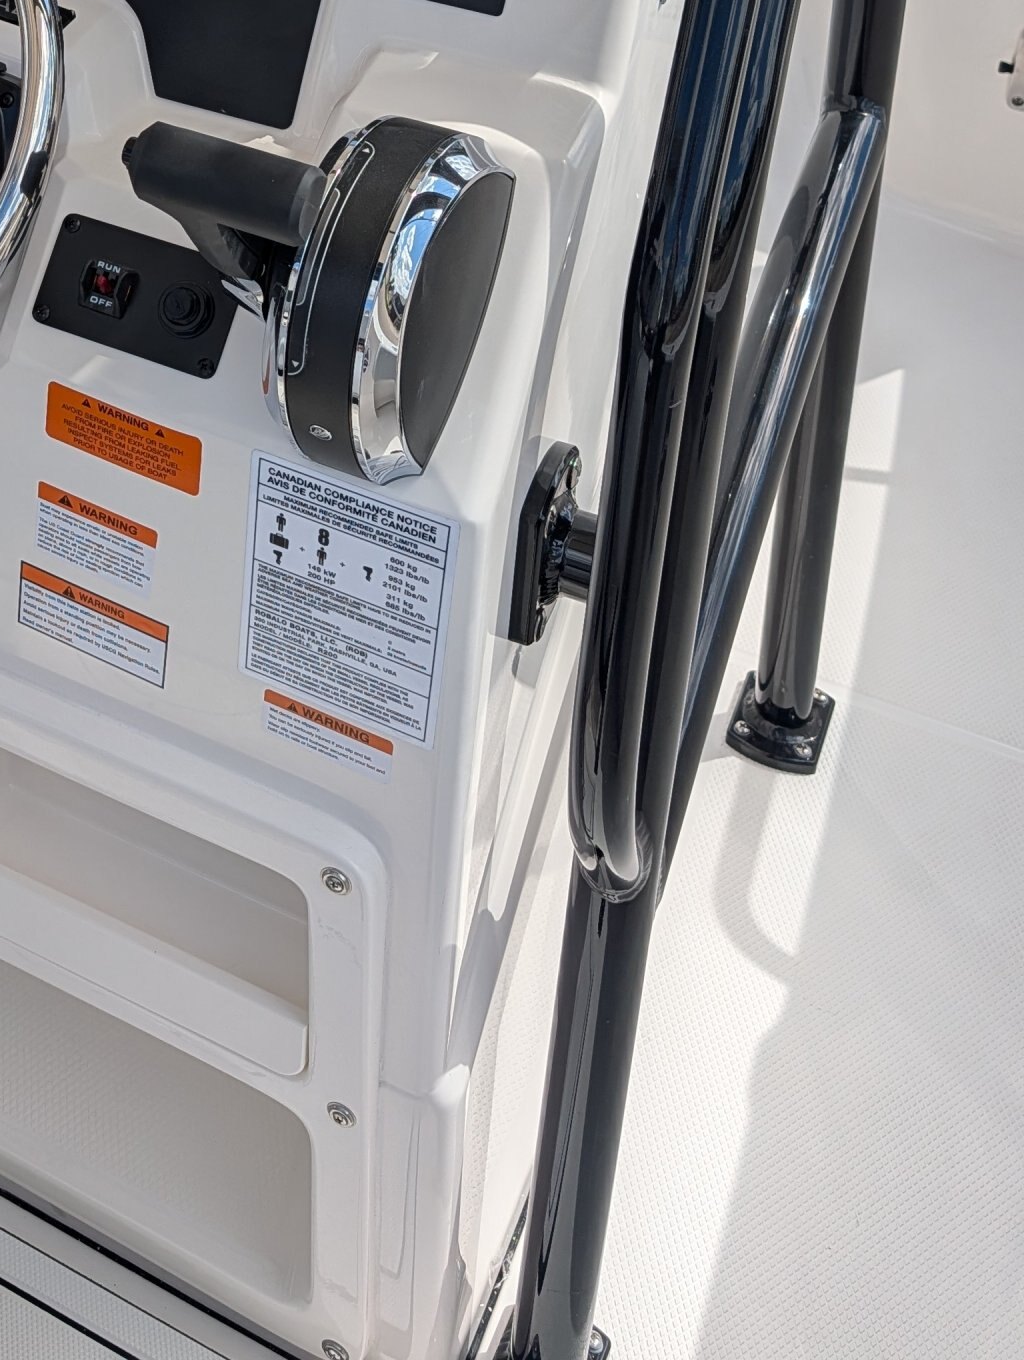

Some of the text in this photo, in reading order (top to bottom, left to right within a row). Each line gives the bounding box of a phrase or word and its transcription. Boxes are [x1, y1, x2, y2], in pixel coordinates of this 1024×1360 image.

[97, 260, 121, 274] RUN
[89, 295, 113, 308] OFF
[61, 402, 183, 457] AVOID SERIOUS INJURY OR DEATH
[97, 402, 149, 432] WARNING
[63, 418, 102, 440] RESULTING
[103, 434, 125, 449] FROM
[127, 444, 159, 462] LEAKING
[67, 427, 176, 477] INSPECT SYSTEMS FOR LEAKS
[74, 415, 170, 459] FROM FIRE OR EXPLOSION
[72, 436, 167, 481] PRIOR TO USAGE OF BOAT
[262, 493, 289, 509] LIMITES
[290, 504, 330, 524] MAXIMALES
[331, 519, 341, 528] DE
[266, 474, 436, 544] AVIS DE CONFORMITÉ CANADIEN
[267, 466, 437, 535] CANADIAN COMPLIANCE NOTICE
[78, 502, 138, 536] WARNING
[283, 494, 418, 550] MAXIMUM RECOMMENDED SAFE LIMITS
[317, 526, 330, 547] 8
[306, 570, 336, 587] 200 HP
[322, 568, 336, 579] kW
[384, 562, 430, 585] 1323 lbs/lb
[389, 556, 418, 573] 600 kg
[381, 579, 428, 603] 2101 lbs/lb
[387, 574, 416, 591] 953 kg
[78, 591, 125, 620] WARNING
[385, 592, 413, 609] 311 kg
[401, 606, 426, 622] lbs/lb
[253, 620, 278, 635] MODEL
[317, 646, 338, 659] R200
[254, 608, 368, 659] ROBALO BOATS, LLC. (ROB)
[266, 620, 305, 640] INDUSTRIAL
[382, 666, 397, 677] USA
[301, 707, 370, 744] WARNING
